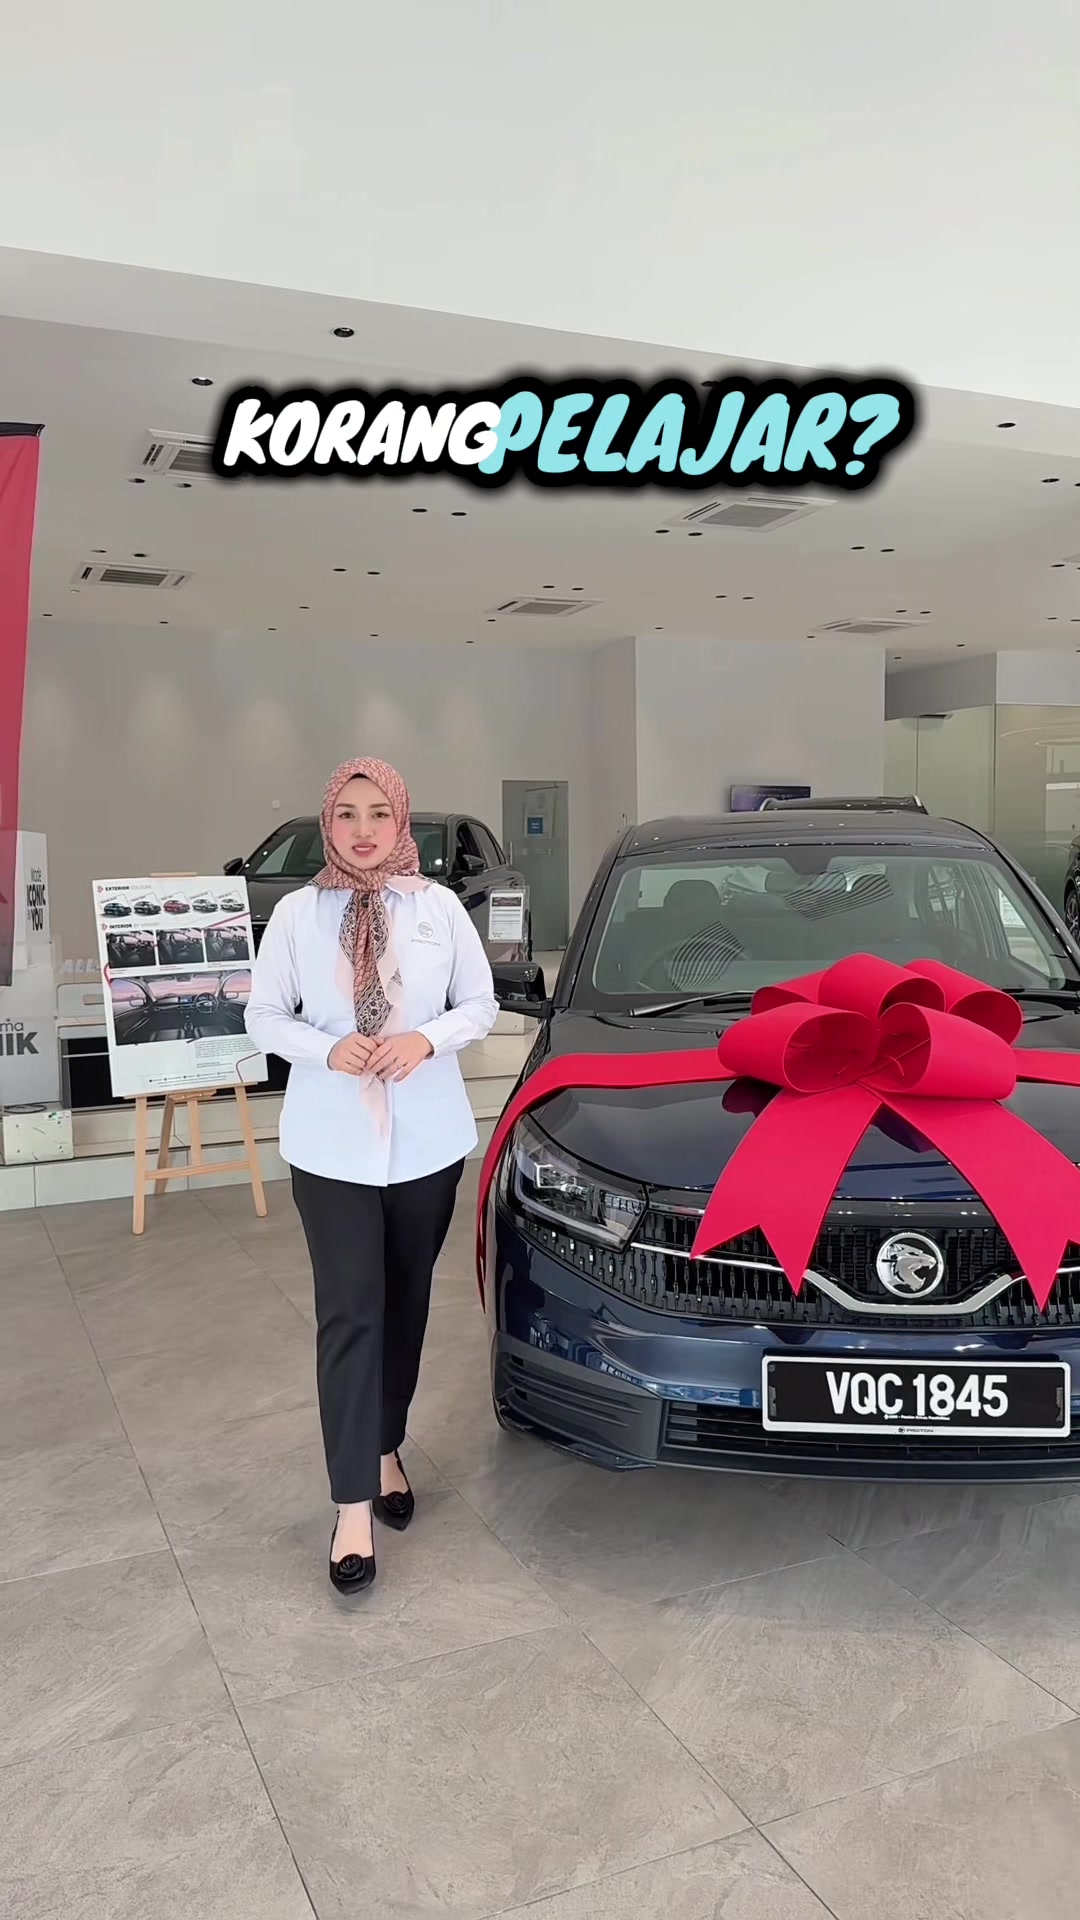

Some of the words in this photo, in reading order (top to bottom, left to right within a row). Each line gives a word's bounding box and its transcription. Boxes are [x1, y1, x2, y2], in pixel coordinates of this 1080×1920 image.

[26, 884, 46, 907] ICONIC
[31, 907, 44, 931] YOU
[0, 1032, 39, 1056] IK
[826, 1371, 903, 1415] VQC
[913, 1373, 1008, 1417] 1845
